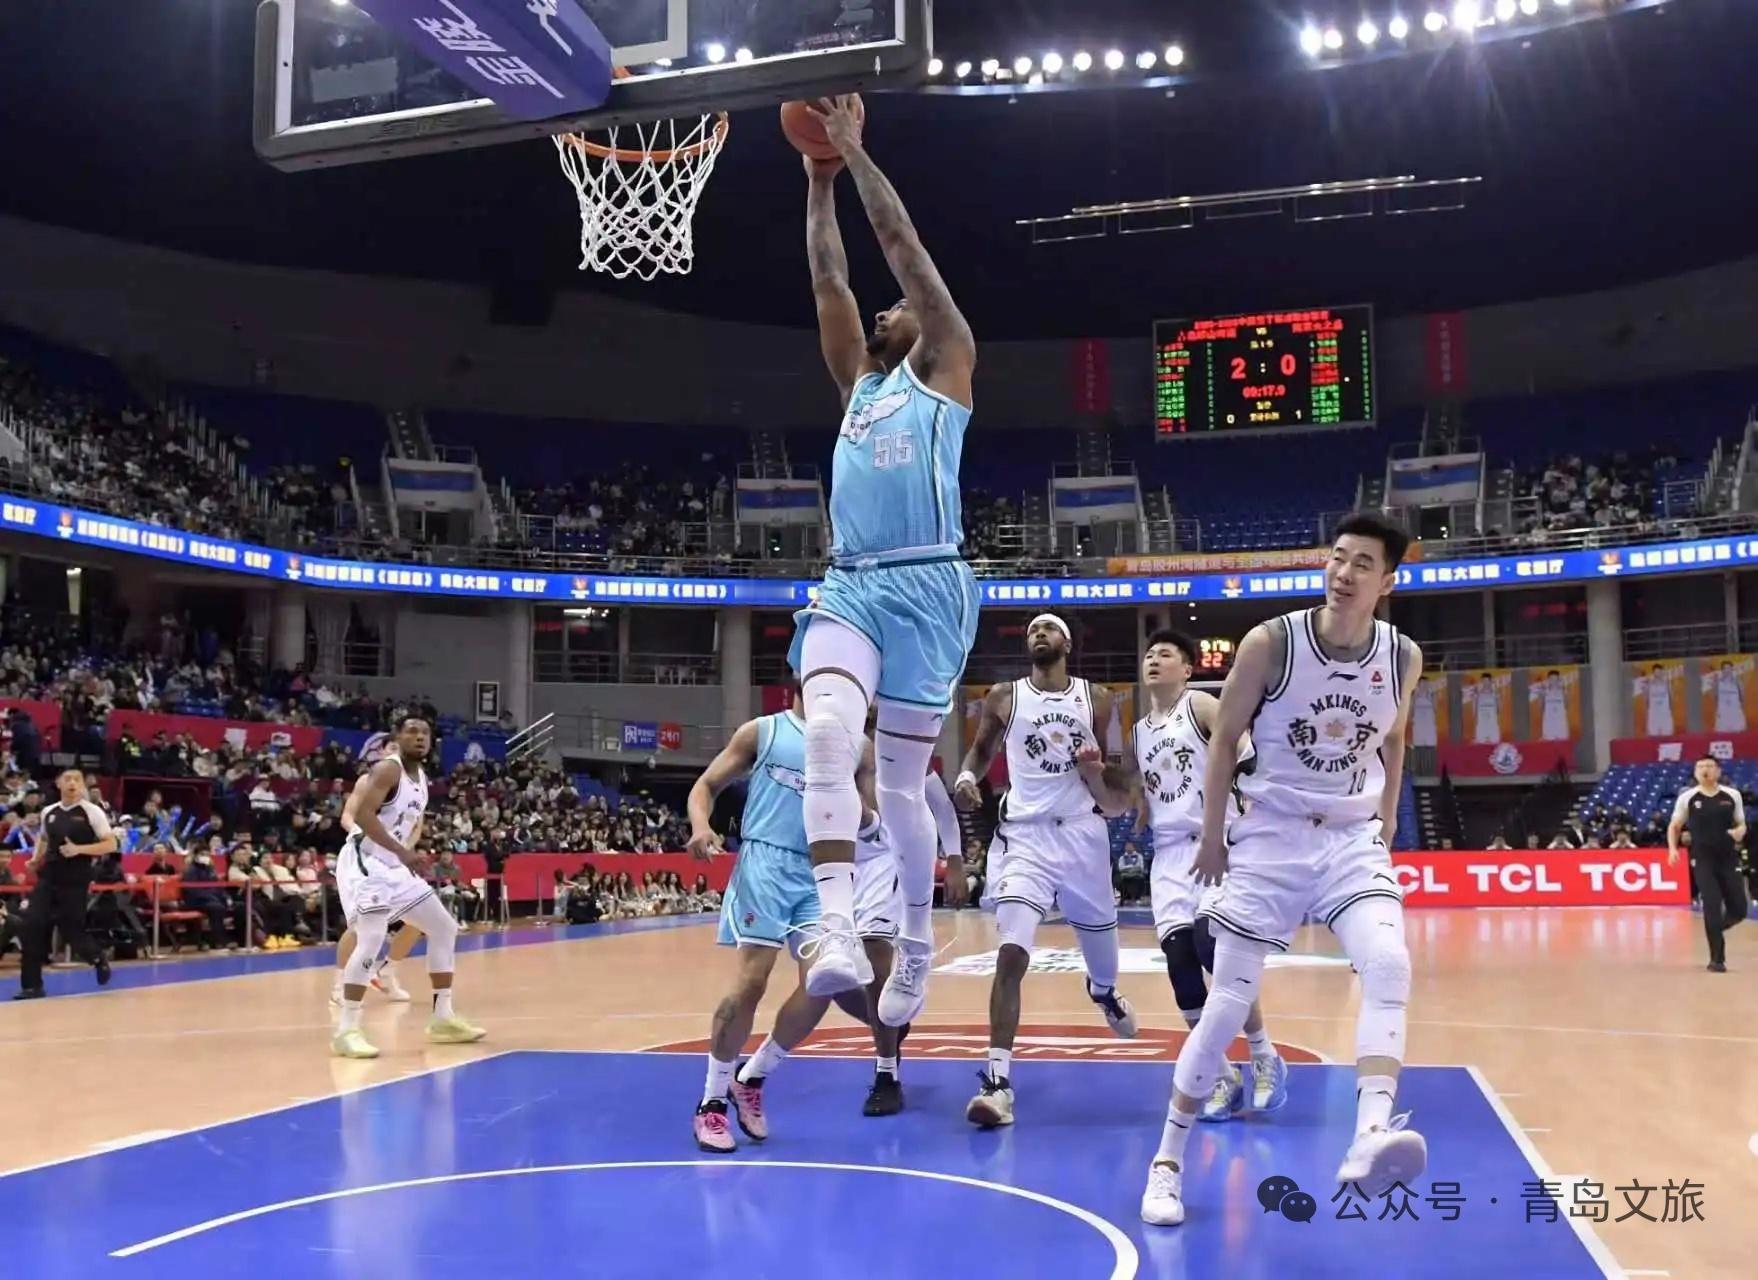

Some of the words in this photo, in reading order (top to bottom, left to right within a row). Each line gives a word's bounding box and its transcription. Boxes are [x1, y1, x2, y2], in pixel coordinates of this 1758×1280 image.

[1231, 358, 1246, 379] 2
[1281, 354, 1296, 375] 0
[873, 430, 914, 470] 55
[1201, 651, 1223, 667] 22
[1287, 717, 1317, 748] 南
[1348, 721, 1379, 752] 京
[1039, 759, 1061, 774] NAN
[1174, 746, 1196, 773] 京
[1297, 747, 1325, 773] NAN
[1325, 751, 1359, 774] JING
[1348, 768, 1367, 795] 10
[1394, 865, 1449, 893] CL
[1467, 865, 1562, 893] TCL
[1579, 863, 1678, 892] TCL
